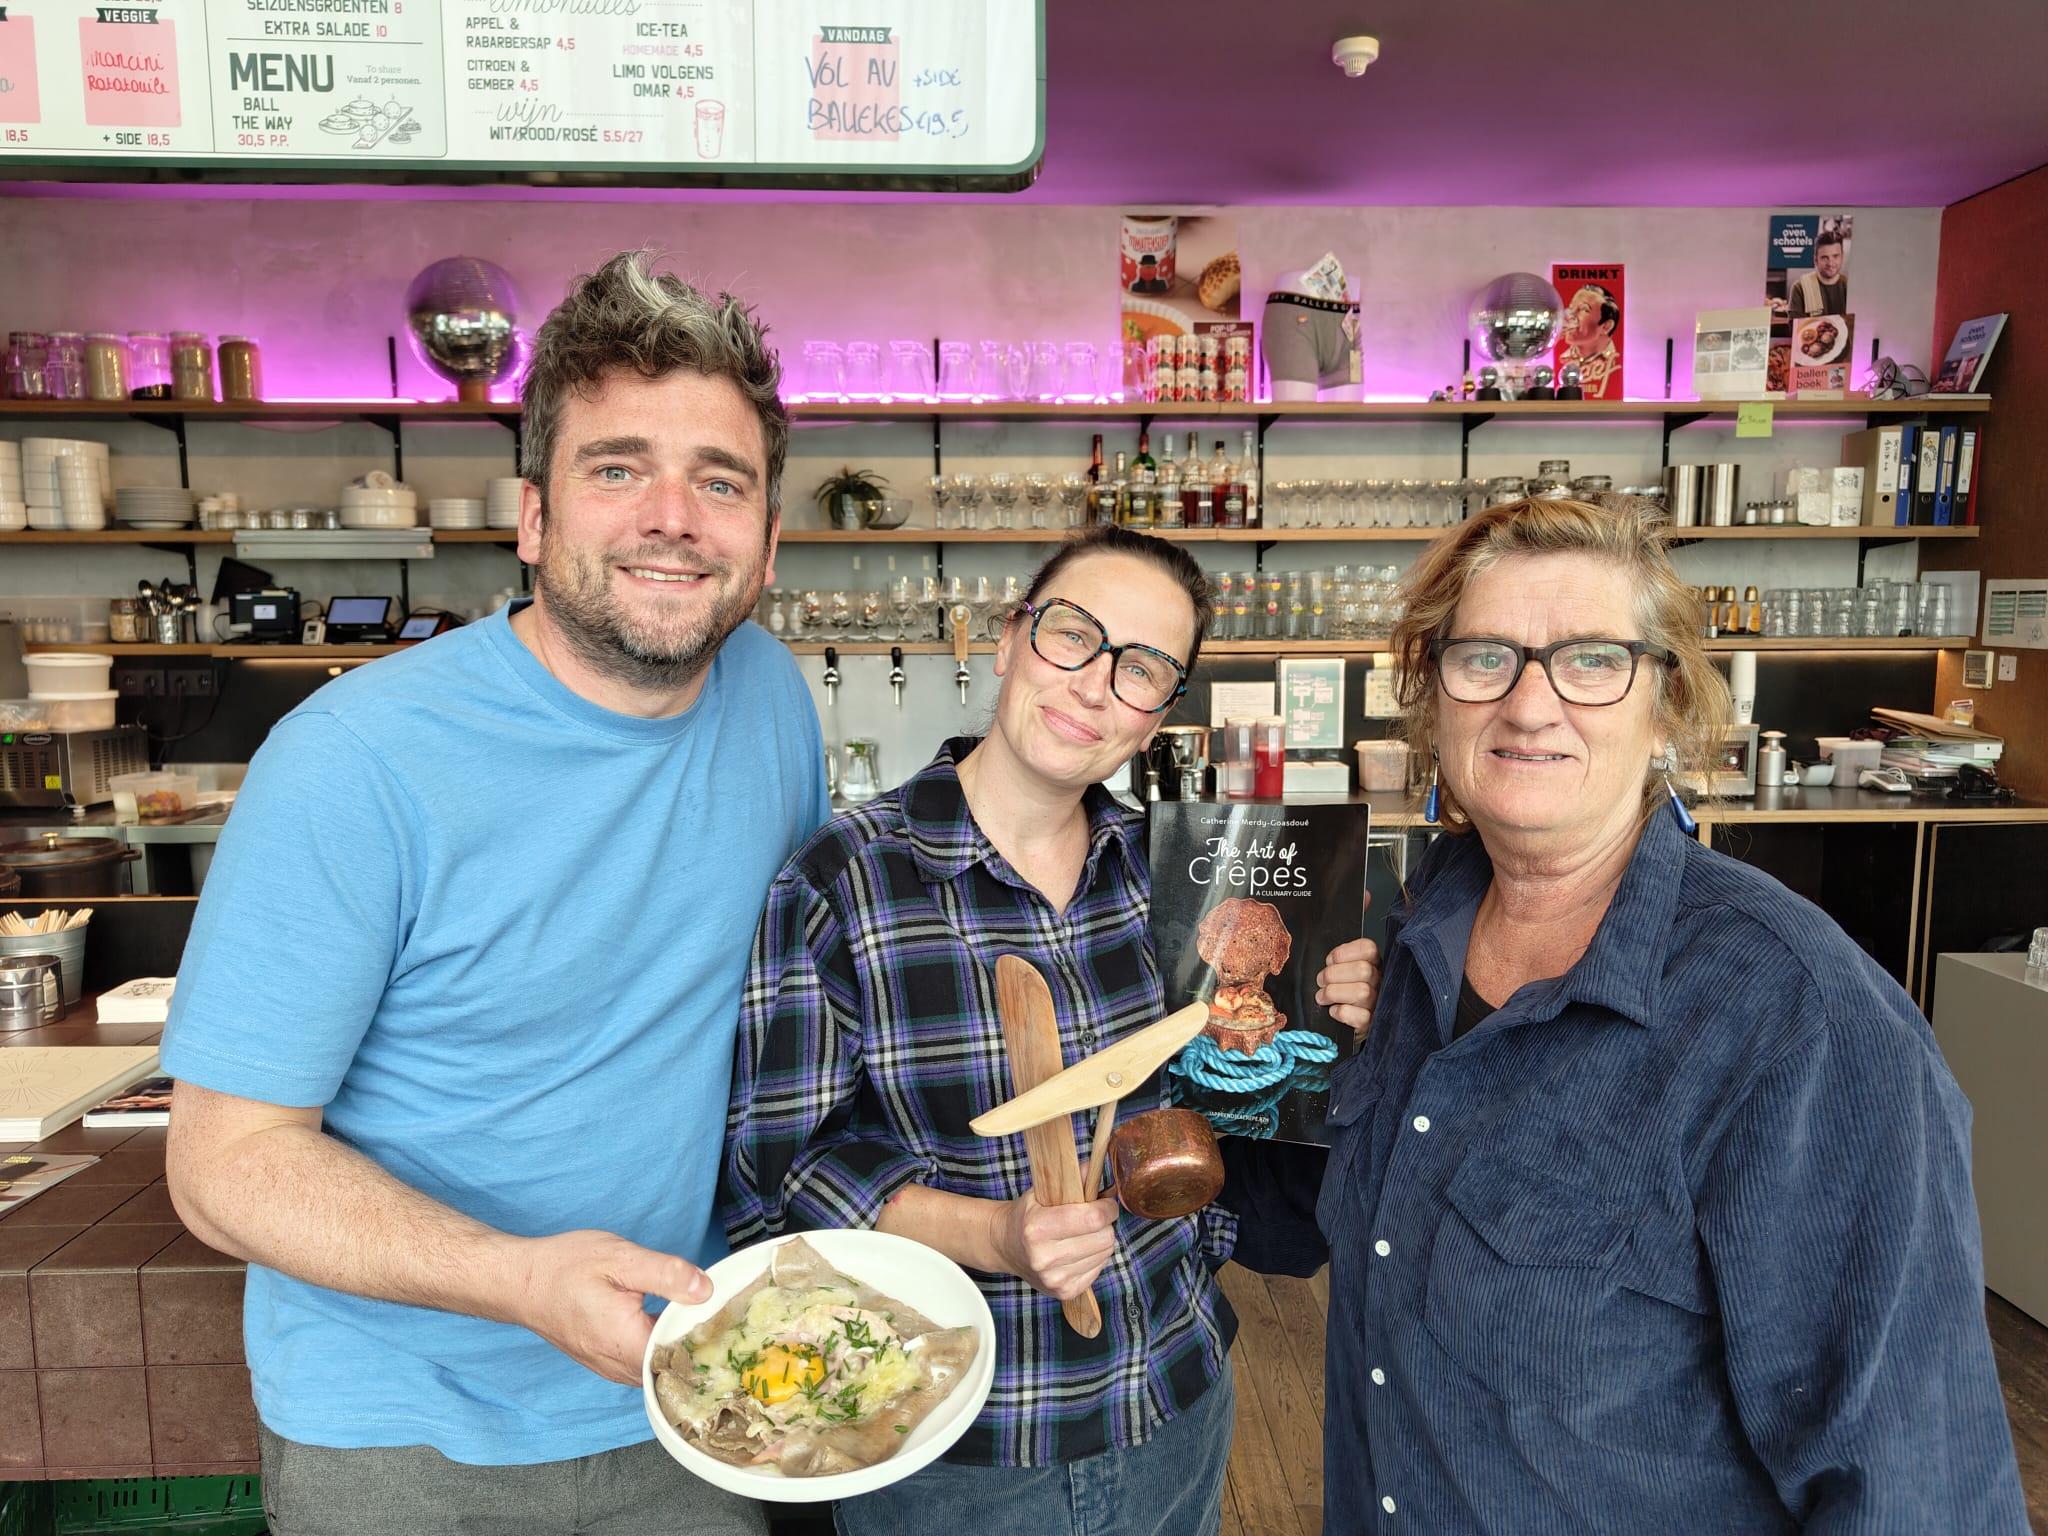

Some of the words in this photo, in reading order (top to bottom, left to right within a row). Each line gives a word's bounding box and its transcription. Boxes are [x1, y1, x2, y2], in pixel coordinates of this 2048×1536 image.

[394, 2, 402, 14] 8
[104, 10, 151, 23] VEGGIE
[466, 17, 504, 29] APPEL
[510, 17, 519, 30] &
[264, 21, 310, 36] EXTRA
[316, 22, 370, 37] SALADE
[376, 25, 388, 38] 10
[636, 22, 688, 37] ICE-TEA
[828, 29, 886, 42] VANDAAG
[466, 36, 551, 49] RABARBERSAP
[556, 38, 576, 51] 4,5
[684, 44, 704, 57] 4,5
[229, 52, 335, 92] MENU
[467, 60, 515, 72] CITROEN
[520, 60, 530, 72] &
[613, 64, 645, 78] LIMO
[652, 65, 714, 80] VOLGENS
[805, 51, 848, 88] VOL
[347, 75, 371, 84] Vanaf
[373, 76, 380, 84] 2
[468, 78, 514, 90] GEMBER
[519, 79, 539, 92] 4,5
[633, 83, 671, 98] OMAR
[676, 85, 695, 99] 4,5
[243, 97, 280, 111] BALL
[497, 97, 563, 128] wijn
[232, 115, 260, 130] THE
[265, 116, 293, 131] WAY
[6, 129, 28, 143] 18,5
[116, 133, 142, 145] SIDE
[148, 134, 170, 146] 18,5
[238, 134, 265, 147] 30,5
[490, 125, 598, 142] WIT/ROOD/ROSÉ
[1782, 229, 1806, 237] oven
[1773, 236, 1813, 246] schotels
[1558, 269, 1620, 280] DRINKT
[1797, 369, 1827, 379] ballen
[1206, 837, 1241, 858] The
[1246, 838, 1276, 859] Art
[1279, 842, 1298, 866] of
[1188, 856, 1307, 896] Crêpes
